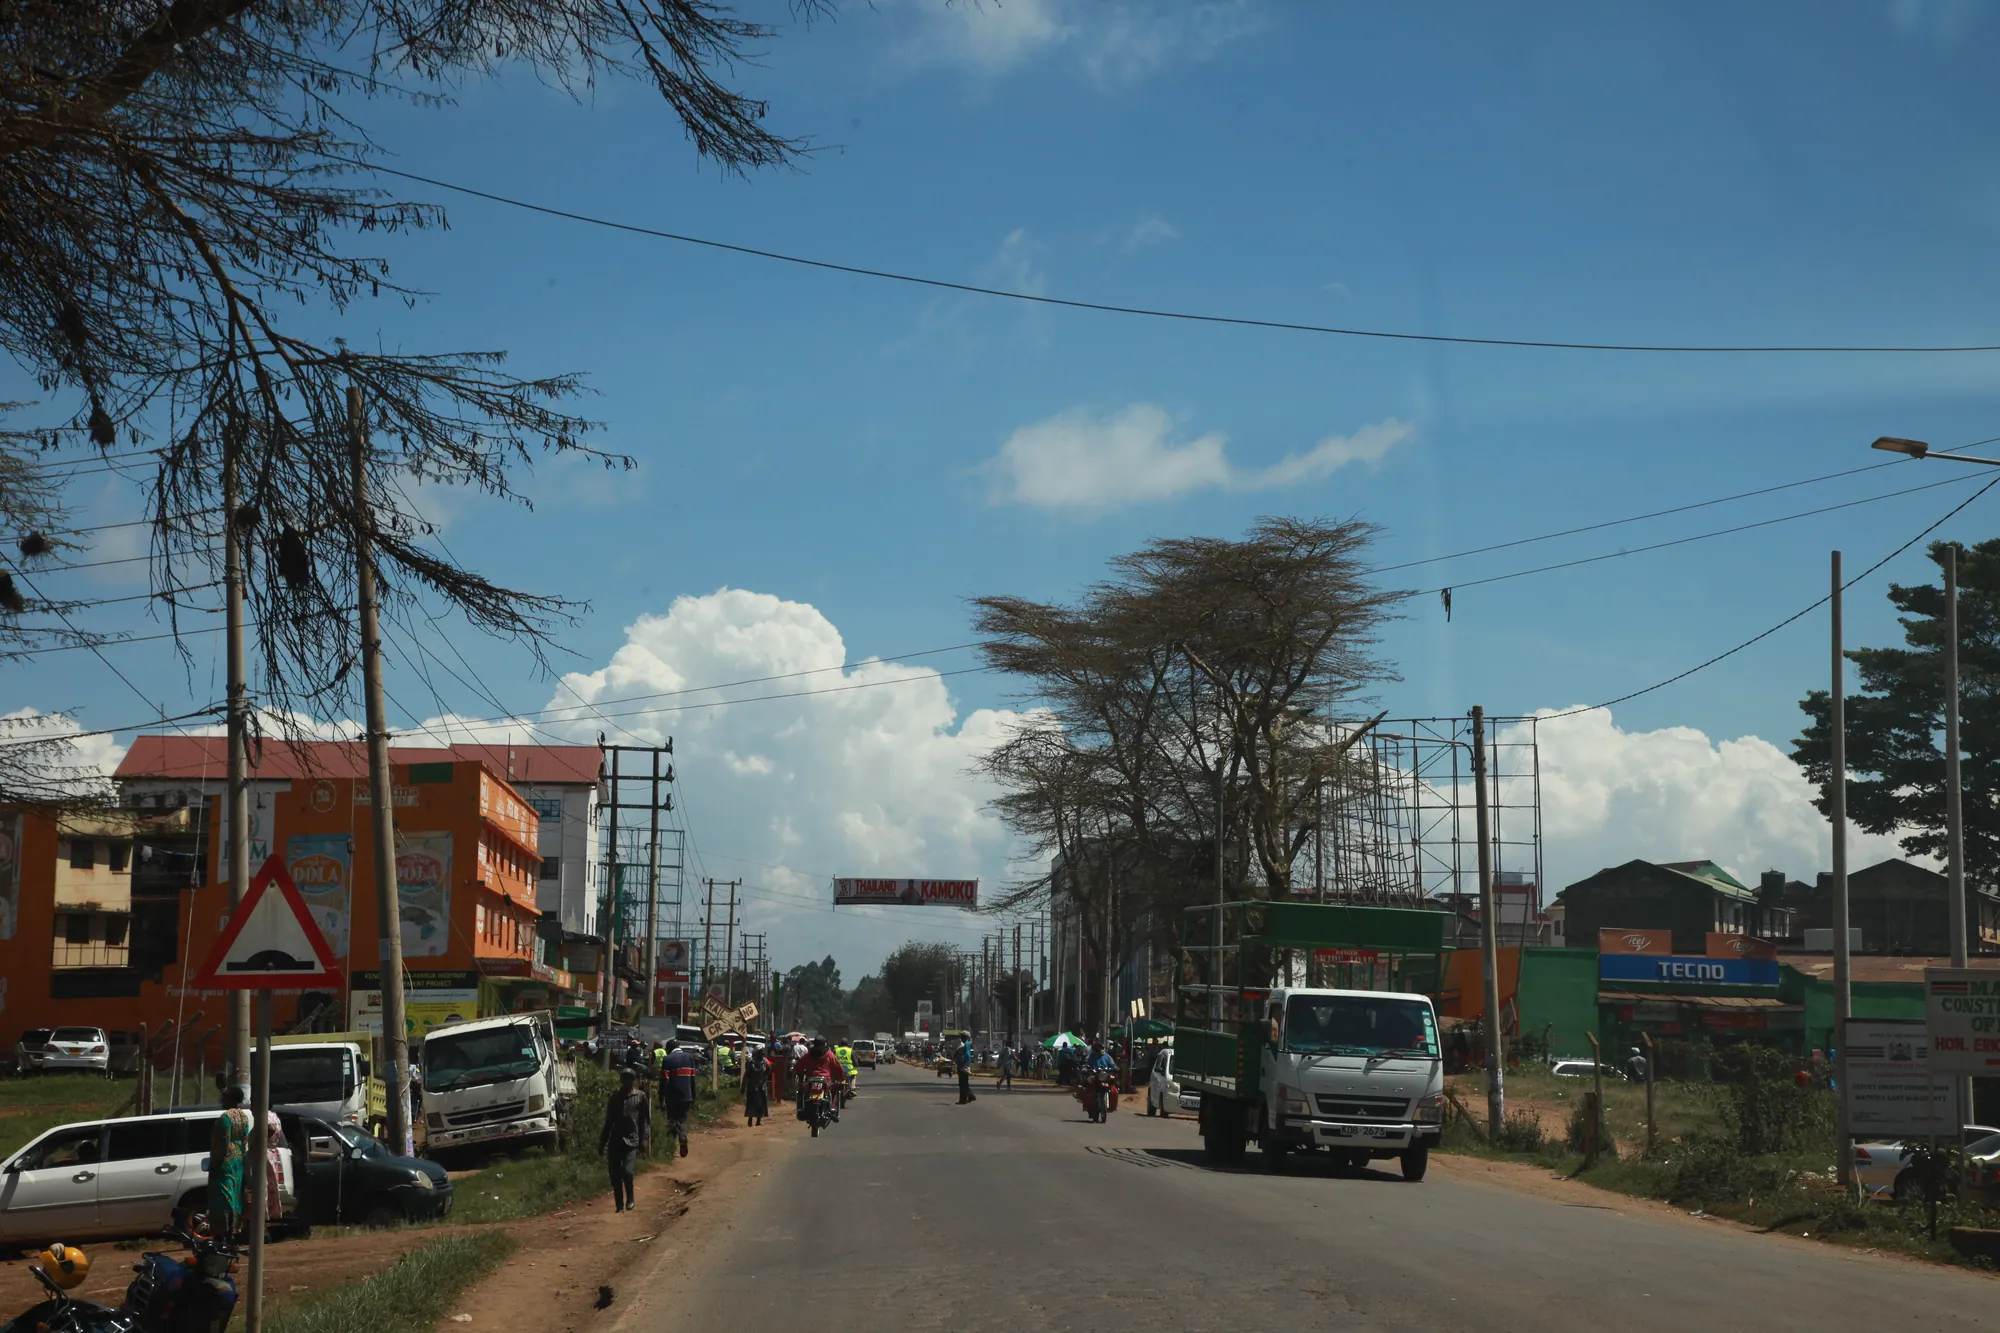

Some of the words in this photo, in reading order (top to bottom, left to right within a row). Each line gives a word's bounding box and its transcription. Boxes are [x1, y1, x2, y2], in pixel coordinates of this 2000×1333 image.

[855, 880, 896, 892] THAILAND
[921, 881, 974, 899] KAMOKO
[1658, 961, 1724, 979] TECNO
[1935, 1036, 1969, 1051] HON.
[1341, 1126, 1358, 1134] KDB
[1363, 1127, 1385, 1136] 267S
